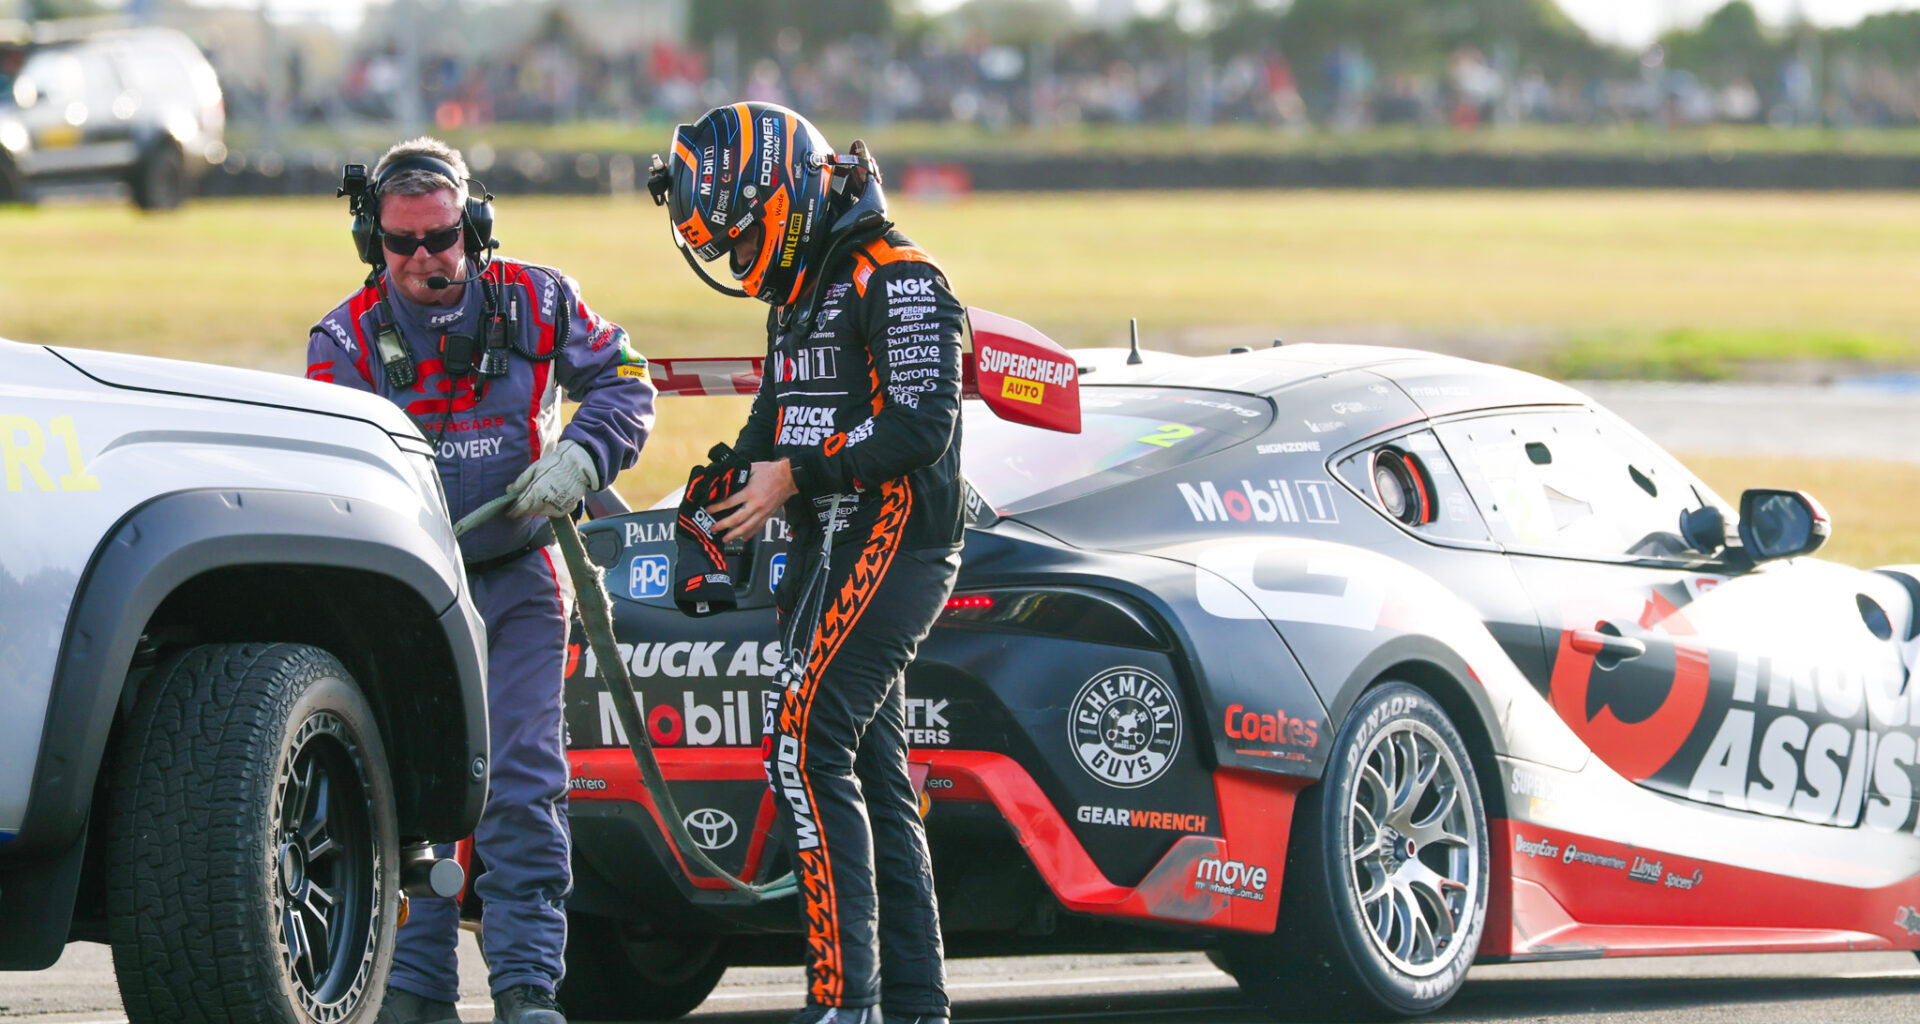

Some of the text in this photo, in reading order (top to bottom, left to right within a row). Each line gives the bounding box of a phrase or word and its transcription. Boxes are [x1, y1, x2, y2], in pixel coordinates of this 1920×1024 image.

[722, 148, 731, 170] LORY
[760, 117, 774, 186] DORMER
[700, 159, 714, 195] Mobil
[775, 193, 785, 217] Wade
[780, 235, 799, 267] DAYLE
[885, 278, 935, 297] NGK
[431, 307, 464, 323] HRX
[888, 306, 937, 317] SUPERCHEAP
[325, 318, 358, 352] HRX
[888, 345, 940, 362] move
[980, 346, 1075, 388] SUPERCHEAP
[890, 368, 940, 382] Acronis
[887, 384, 925, 396] Spicers
[1006, 382, 1040, 398] AUTO
[783, 406, 837, 427] RUCK
[1136, 424, 1195, 448] 2
[1255, 441, 1321, 454] SIGNZONE
[0, 414, 101, 492] R1
[1177, 479, 1300, 522] Mobil
[624, 522, 676, 547] PALM
[695, 510, 714, 532] OM
[631, 559, 667, 594] PPG
[598, 690, 752, 746] Mobil
[905, 699, 950, 728] TK
[1078, 676, 1174, 735] CHEMICAL
[904, 729, 951, 744] TERS
[1224, 704, 1319, 748] Coates
[1347, 696, 1418, 770] DUNLOP
[1091, 749, 1152, 779] GUYS
[1687, 706, 1920, 834] ASSIS
[778, 734, 820, 850] WOOD
[1077, 806, 1206, 832] GEARWRENCH
[1197, 857, 1268, 890] move
[1631, 857, 1663, 878] Lloyds
[1665, 873, 1694, 890] Spicers
